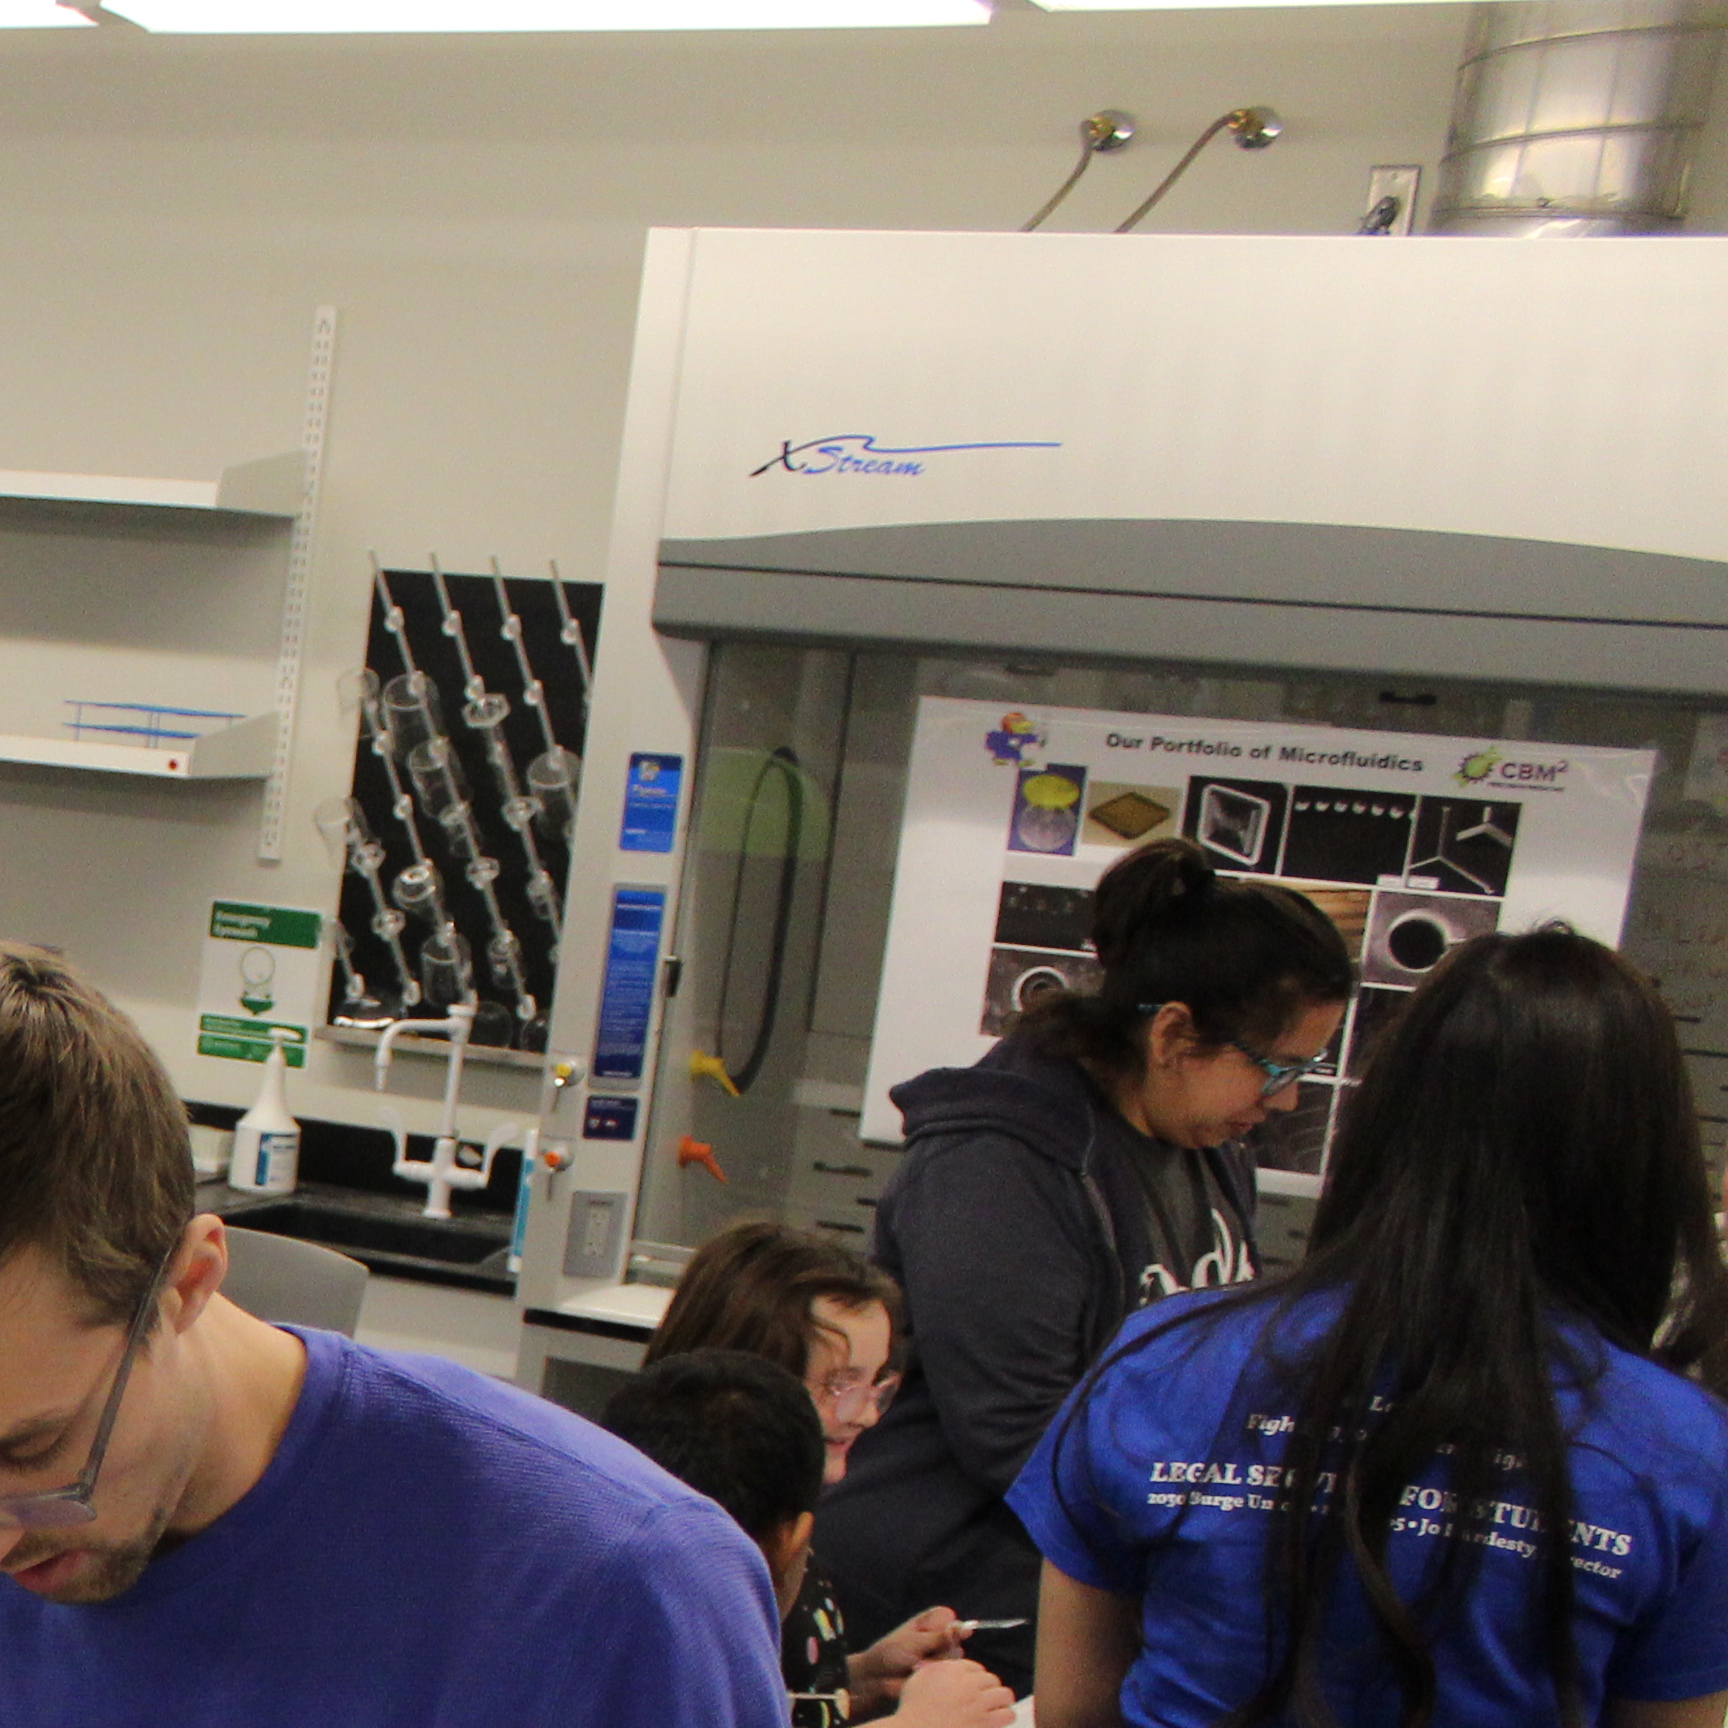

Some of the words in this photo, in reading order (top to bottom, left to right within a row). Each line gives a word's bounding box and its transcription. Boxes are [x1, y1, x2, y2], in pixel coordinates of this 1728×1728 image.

[1106, 733, 1142, 751] Our
[1151, 735, 1243, 758] Portfolio
[1249, 744, 1269, 759] of
[1278, 746, 1424, 773] Microfluidics
[1150, 1462, 1242, 1485] LEGAL
[1418, 1518, 1441, 1537] Jo
